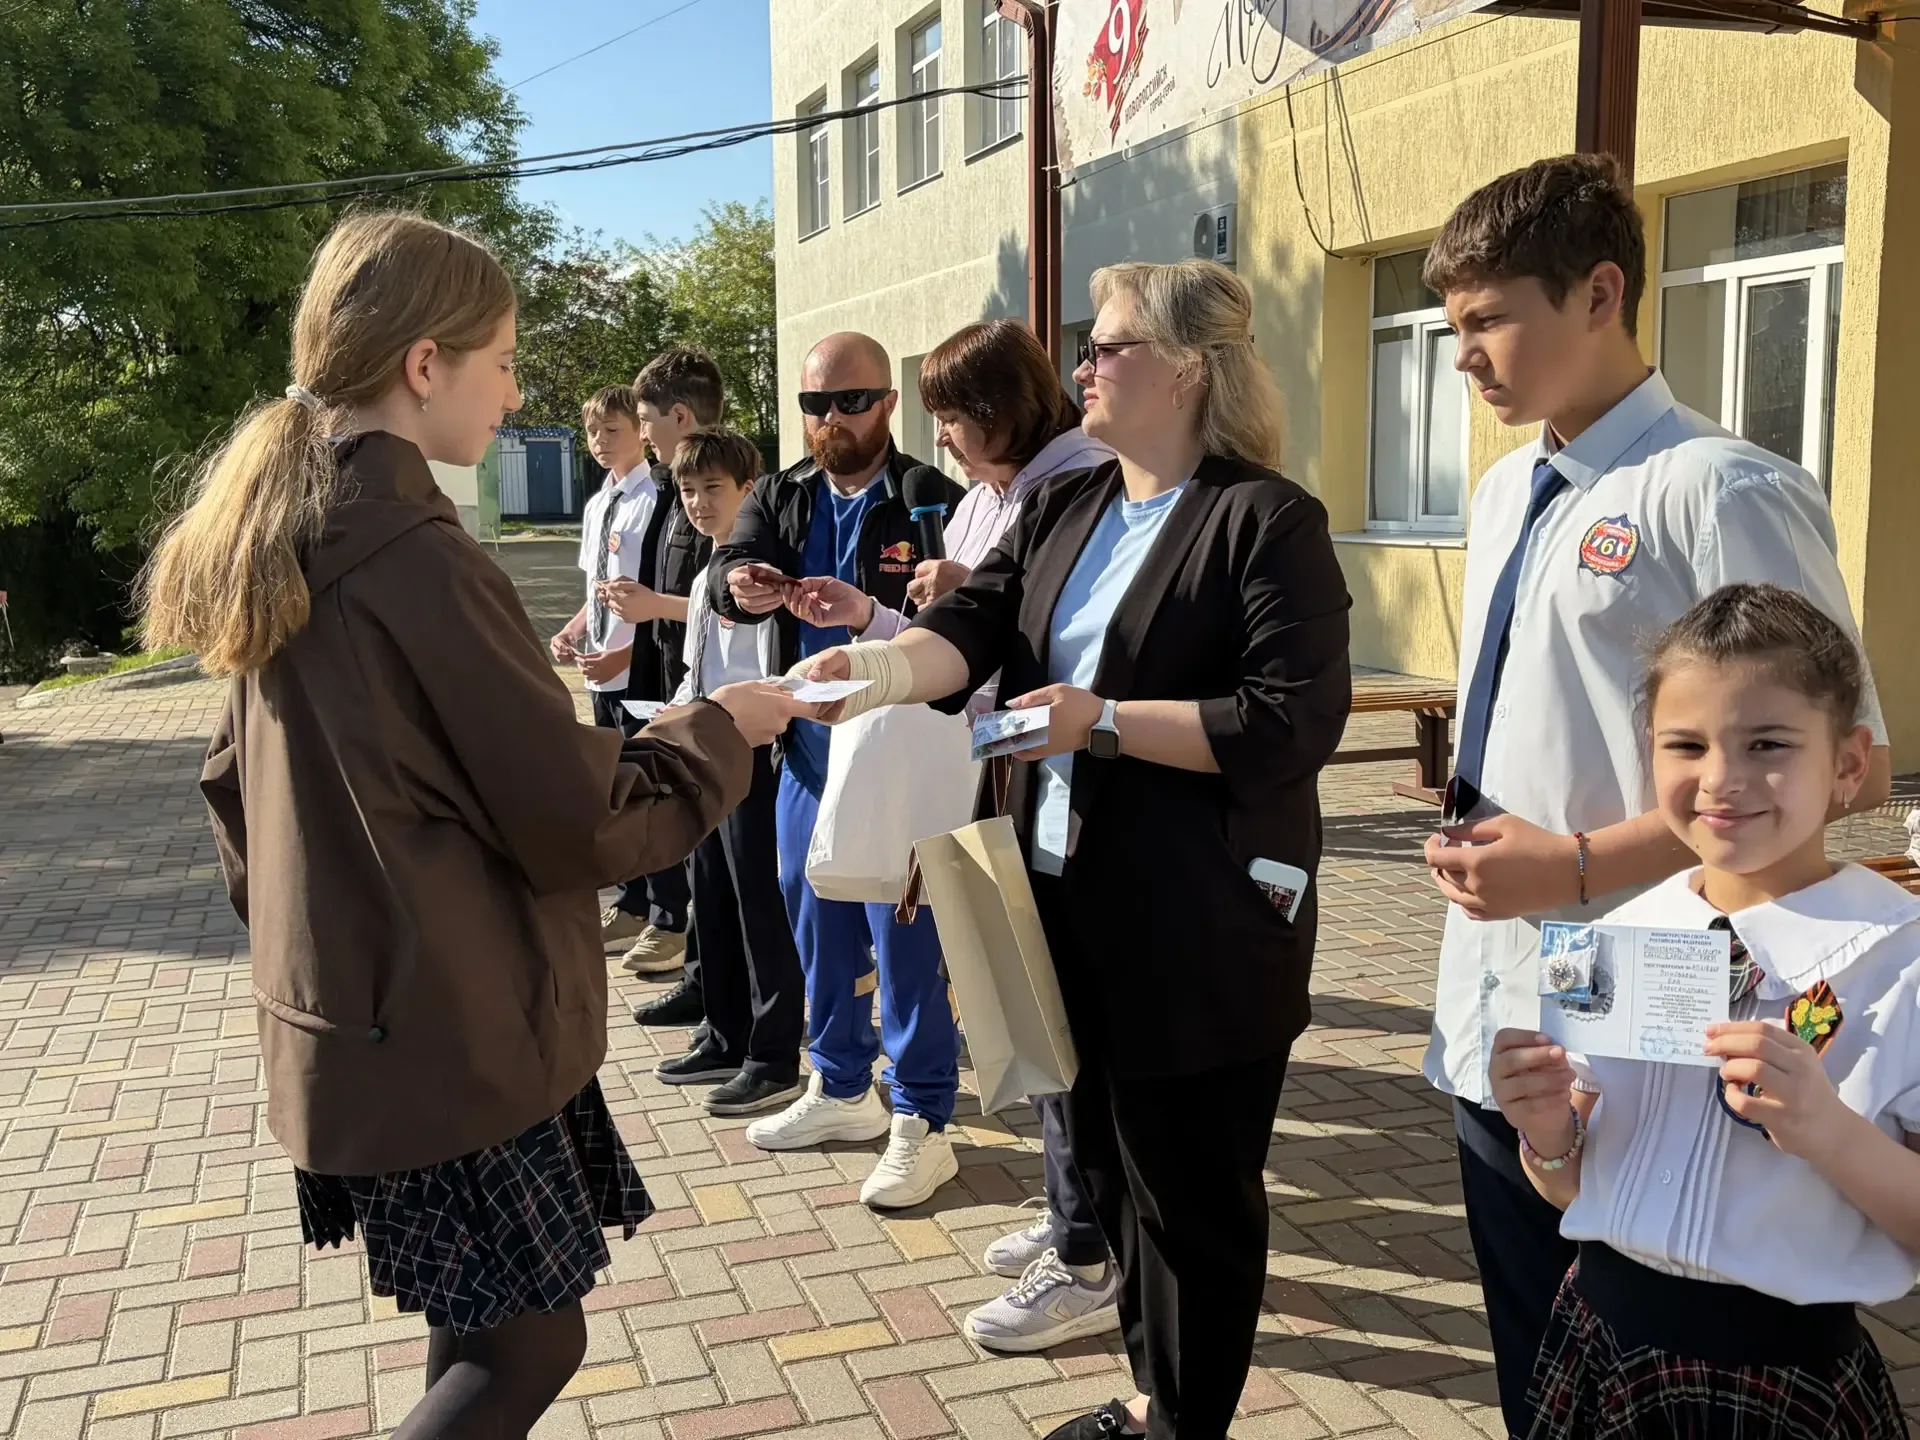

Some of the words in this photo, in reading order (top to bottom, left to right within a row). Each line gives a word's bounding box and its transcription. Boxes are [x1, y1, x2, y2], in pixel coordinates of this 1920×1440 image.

[1108, 0, 1130, 85] 9
[1124, 63, 1168, 124] НОВОРОССИЙСК
[1149, 76, 1176, 114] ГОРОД-ГЕРОЙ
[1600, 538, 1617, 555] 6
